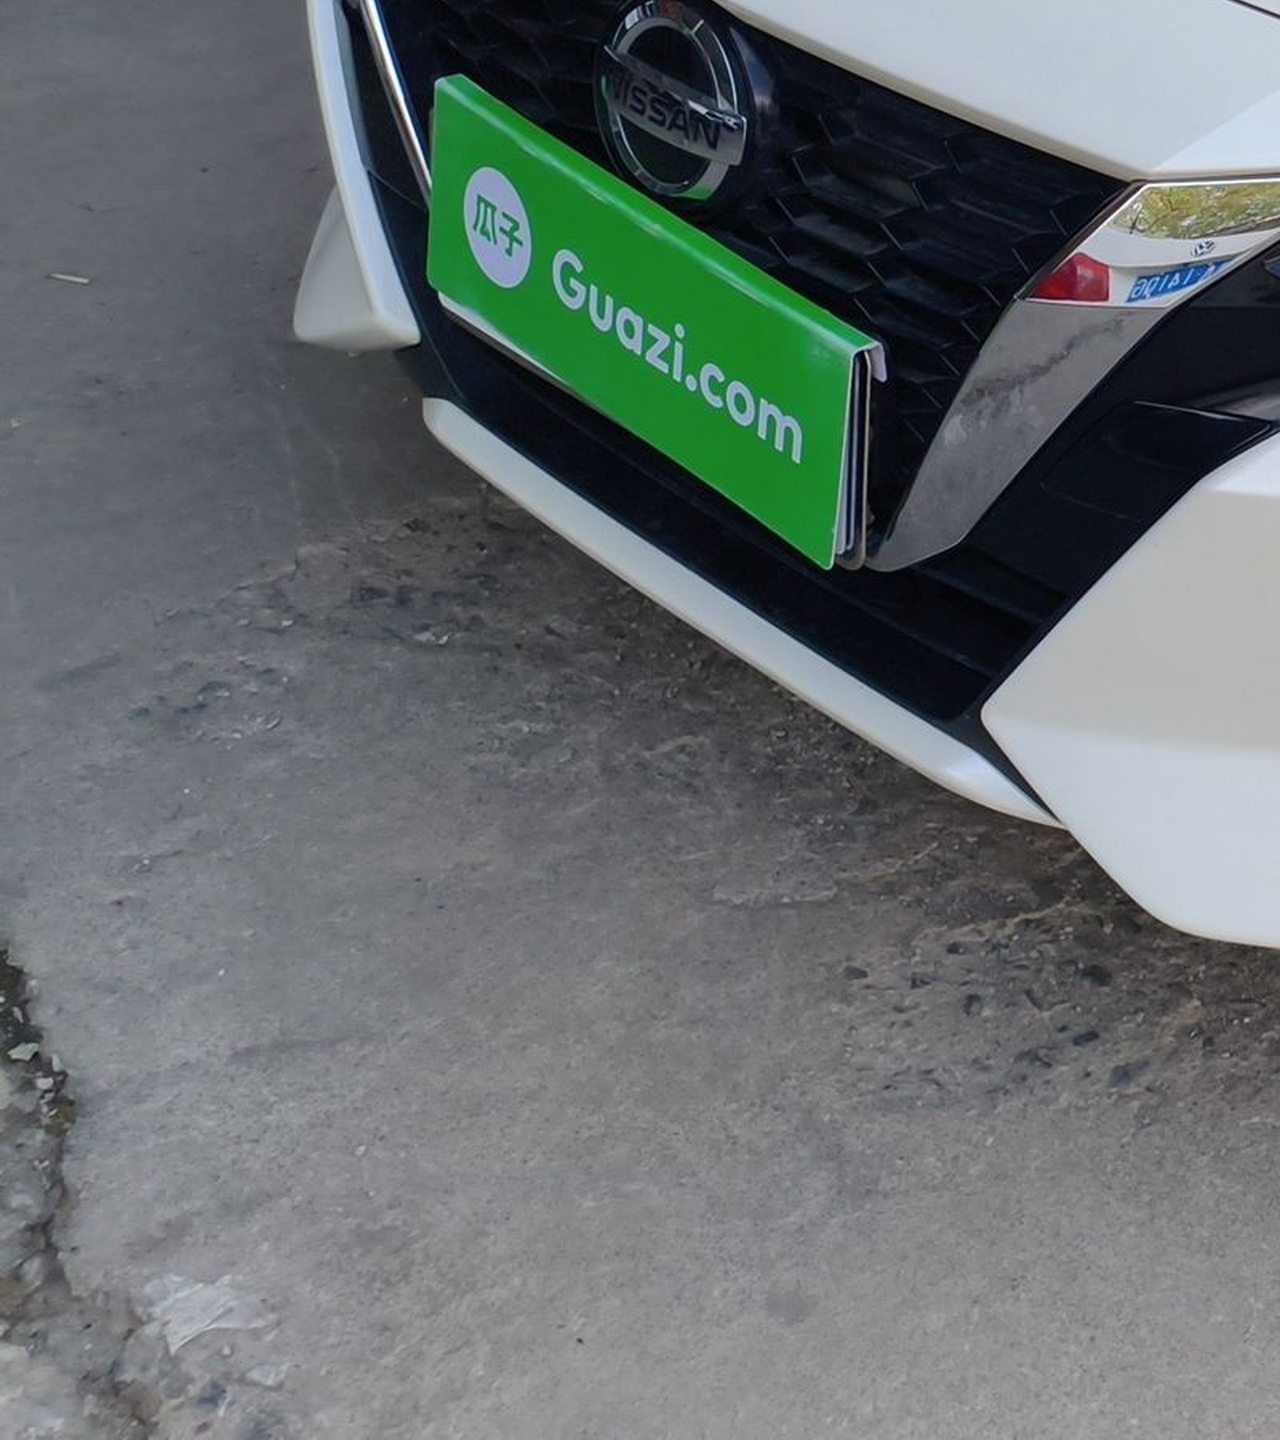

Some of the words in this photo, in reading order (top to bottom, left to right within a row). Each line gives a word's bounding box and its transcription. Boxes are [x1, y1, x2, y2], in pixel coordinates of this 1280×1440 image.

[612, 70, 722, 151] NISSAN
[473, 194, 524, 258] 瓜子
[552, 248, 803, 464] Guazi.com
